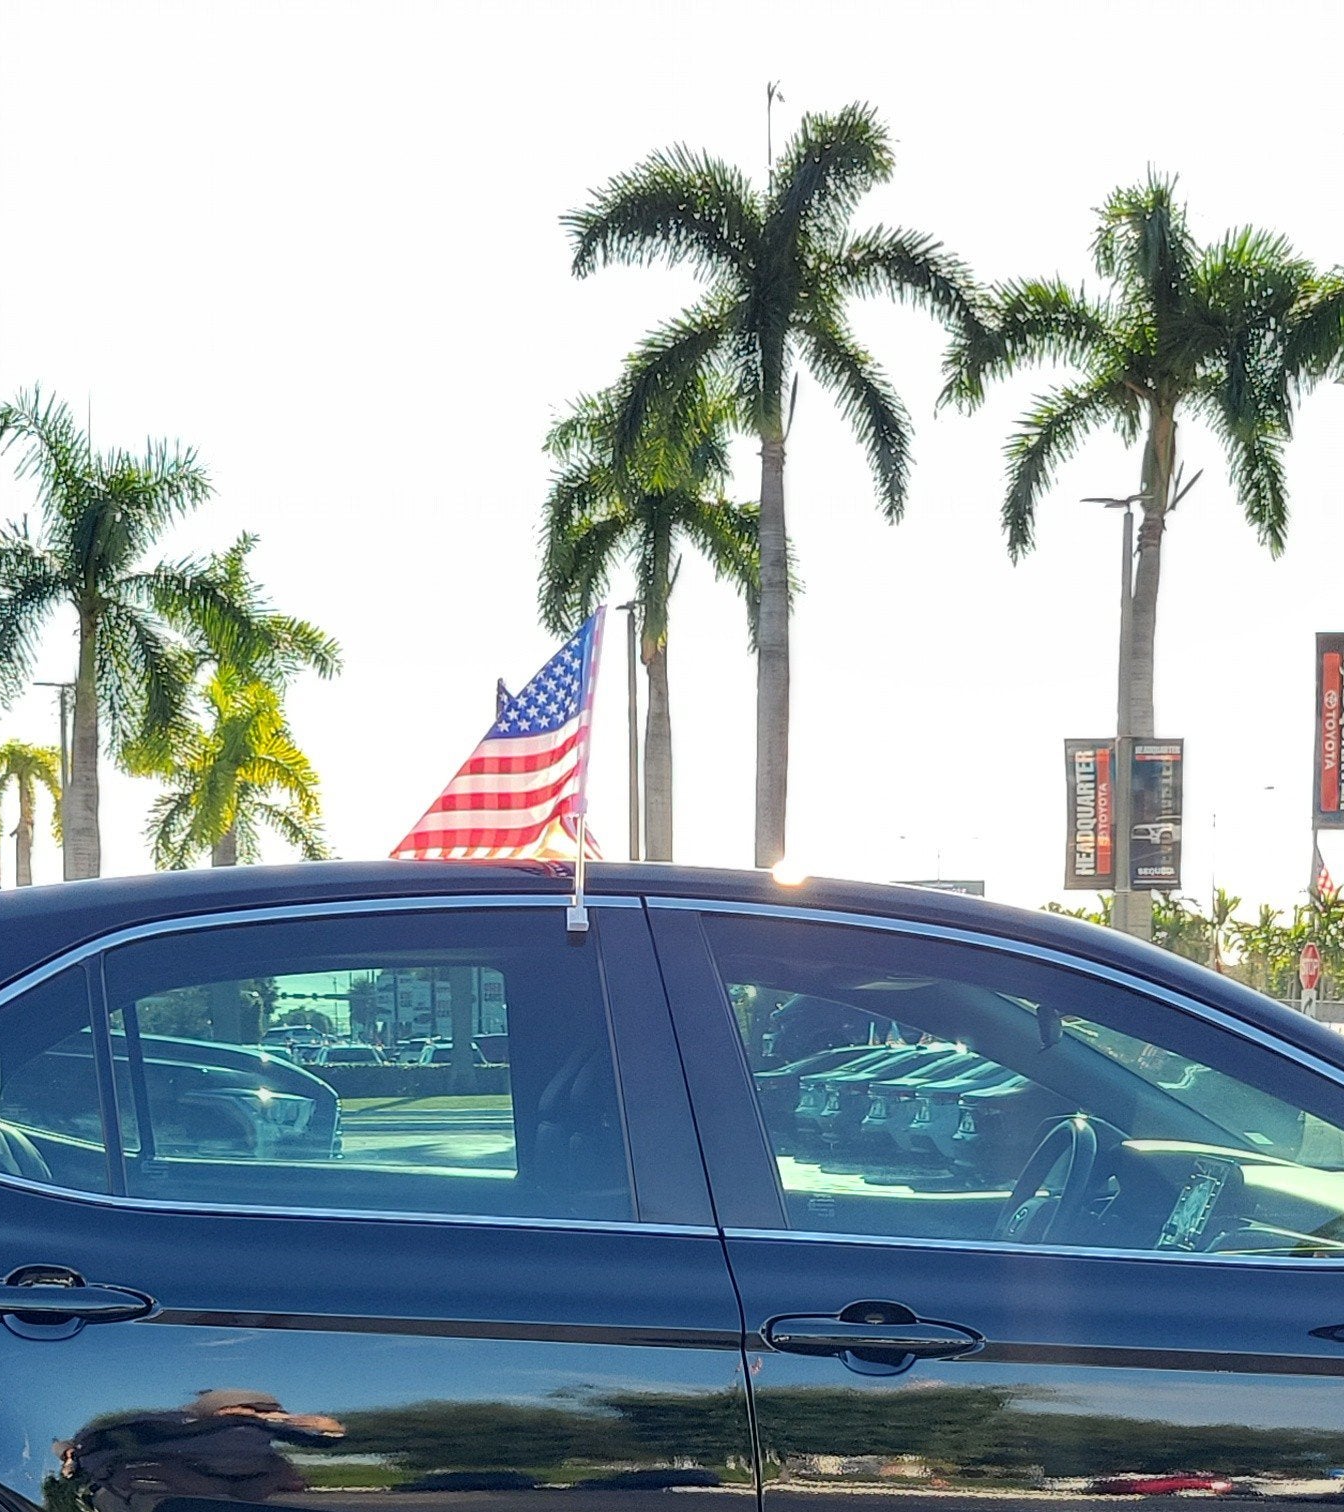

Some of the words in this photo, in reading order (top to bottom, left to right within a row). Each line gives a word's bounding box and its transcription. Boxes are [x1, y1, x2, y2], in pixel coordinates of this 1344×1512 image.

[1325, 710, 1336, 770] TOYOTA
[1075, 750, 1096, 876] HEADQUARTER
[1098, 783, 1109, 837] TOYOTA
